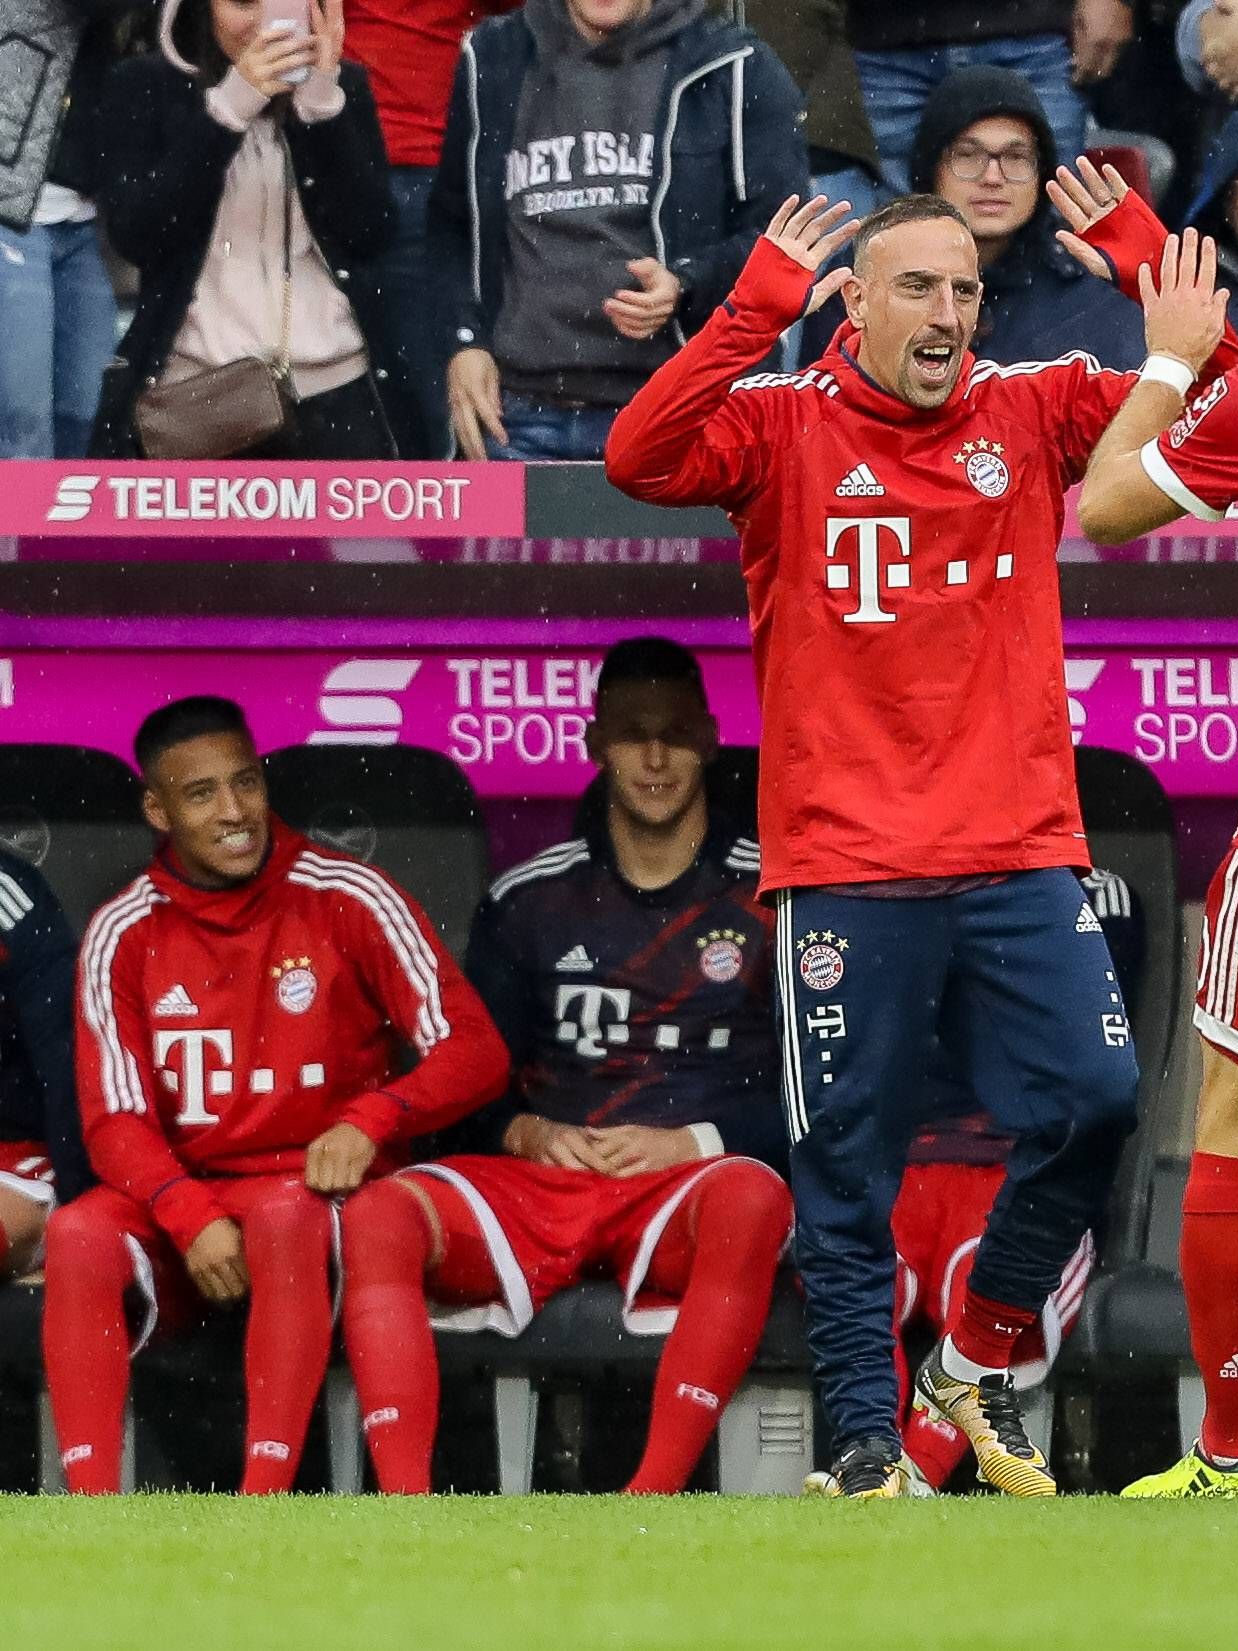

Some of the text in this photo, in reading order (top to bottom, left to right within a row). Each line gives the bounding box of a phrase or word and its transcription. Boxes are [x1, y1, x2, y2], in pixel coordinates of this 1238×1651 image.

[581, 130, 654, 177] ISLA
[109, 477, 471, 521] TELEKOM SPORT
[834, 483, 886, 497] adidas
[446, 659, 600, 707] TELEK
[447, 712, 594, 763] SPOR
